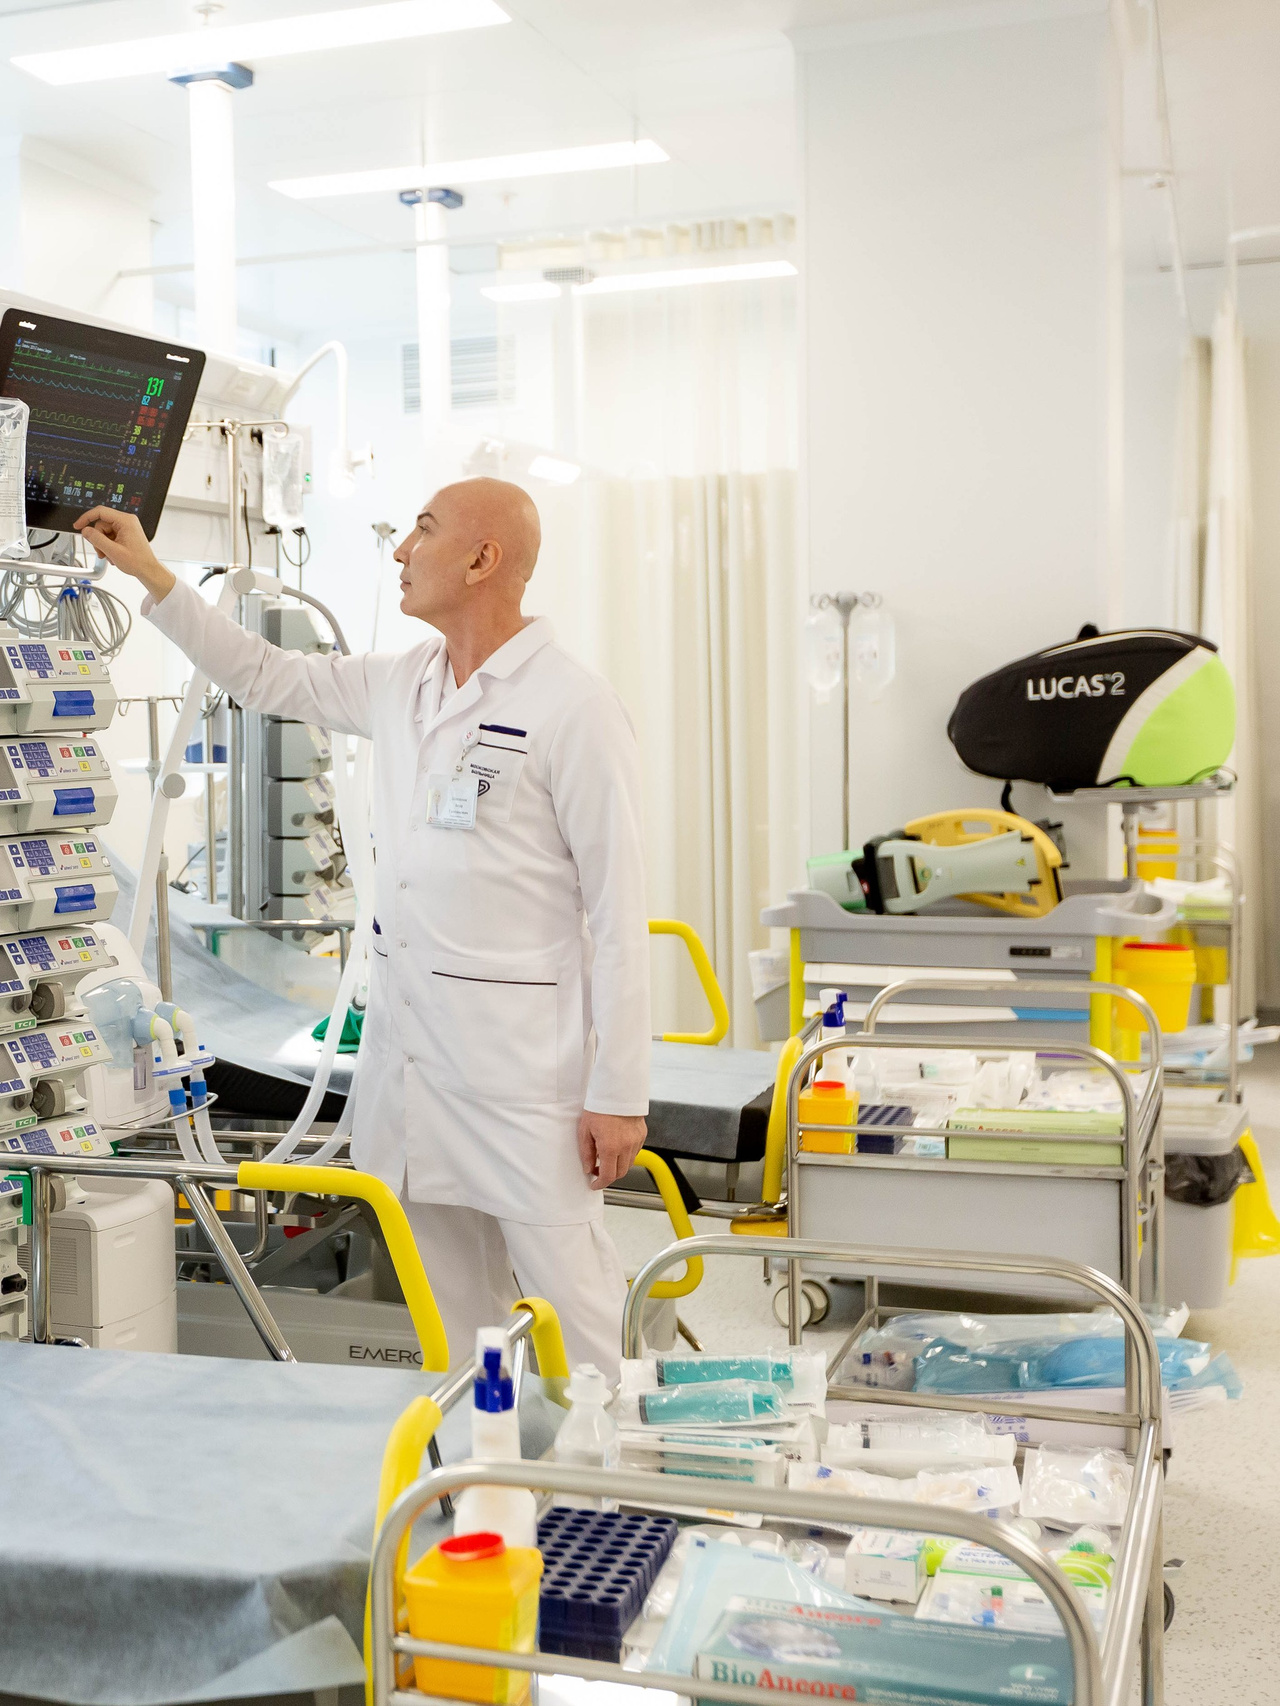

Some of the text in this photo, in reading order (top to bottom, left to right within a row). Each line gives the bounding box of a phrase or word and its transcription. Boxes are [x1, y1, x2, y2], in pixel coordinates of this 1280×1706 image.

[146, 376, 165, 397] 131
[141, 395, 151, 406] 82
[1027, 674, 1106, 701] LUCAS
[19, 1118, 33, 1126] TCI
[710, 1659, 857, 1701] BioAncore
